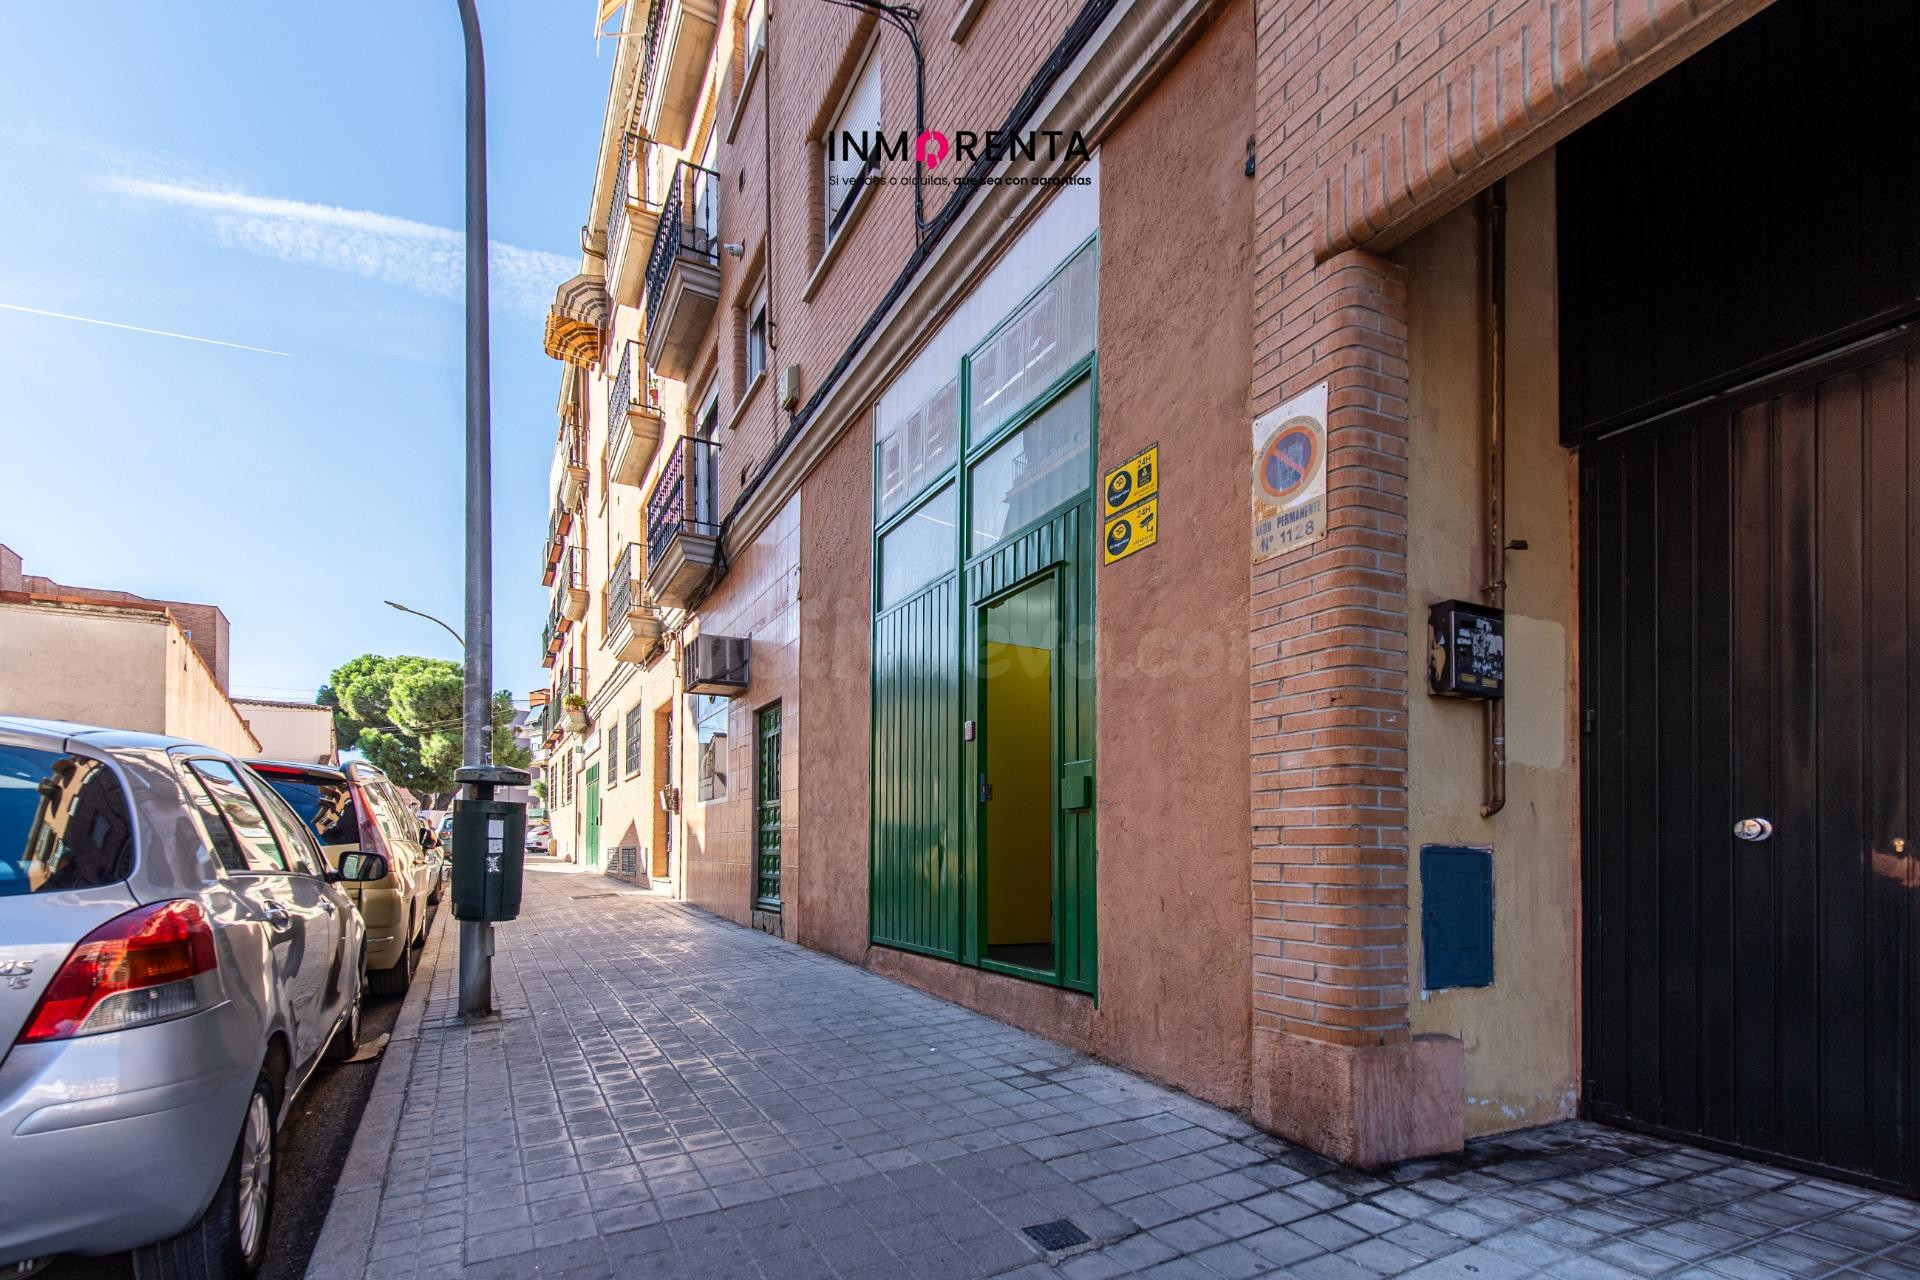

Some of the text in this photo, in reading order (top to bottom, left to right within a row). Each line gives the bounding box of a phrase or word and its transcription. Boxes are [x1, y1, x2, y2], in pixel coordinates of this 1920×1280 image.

[1137, 454, 1151, 468] 24H
[1137, 505, 1151, 518] 24H
[1276, 501, 1321, 528] PERMANENTE
[1280, 520, 1314, 543] 1128
